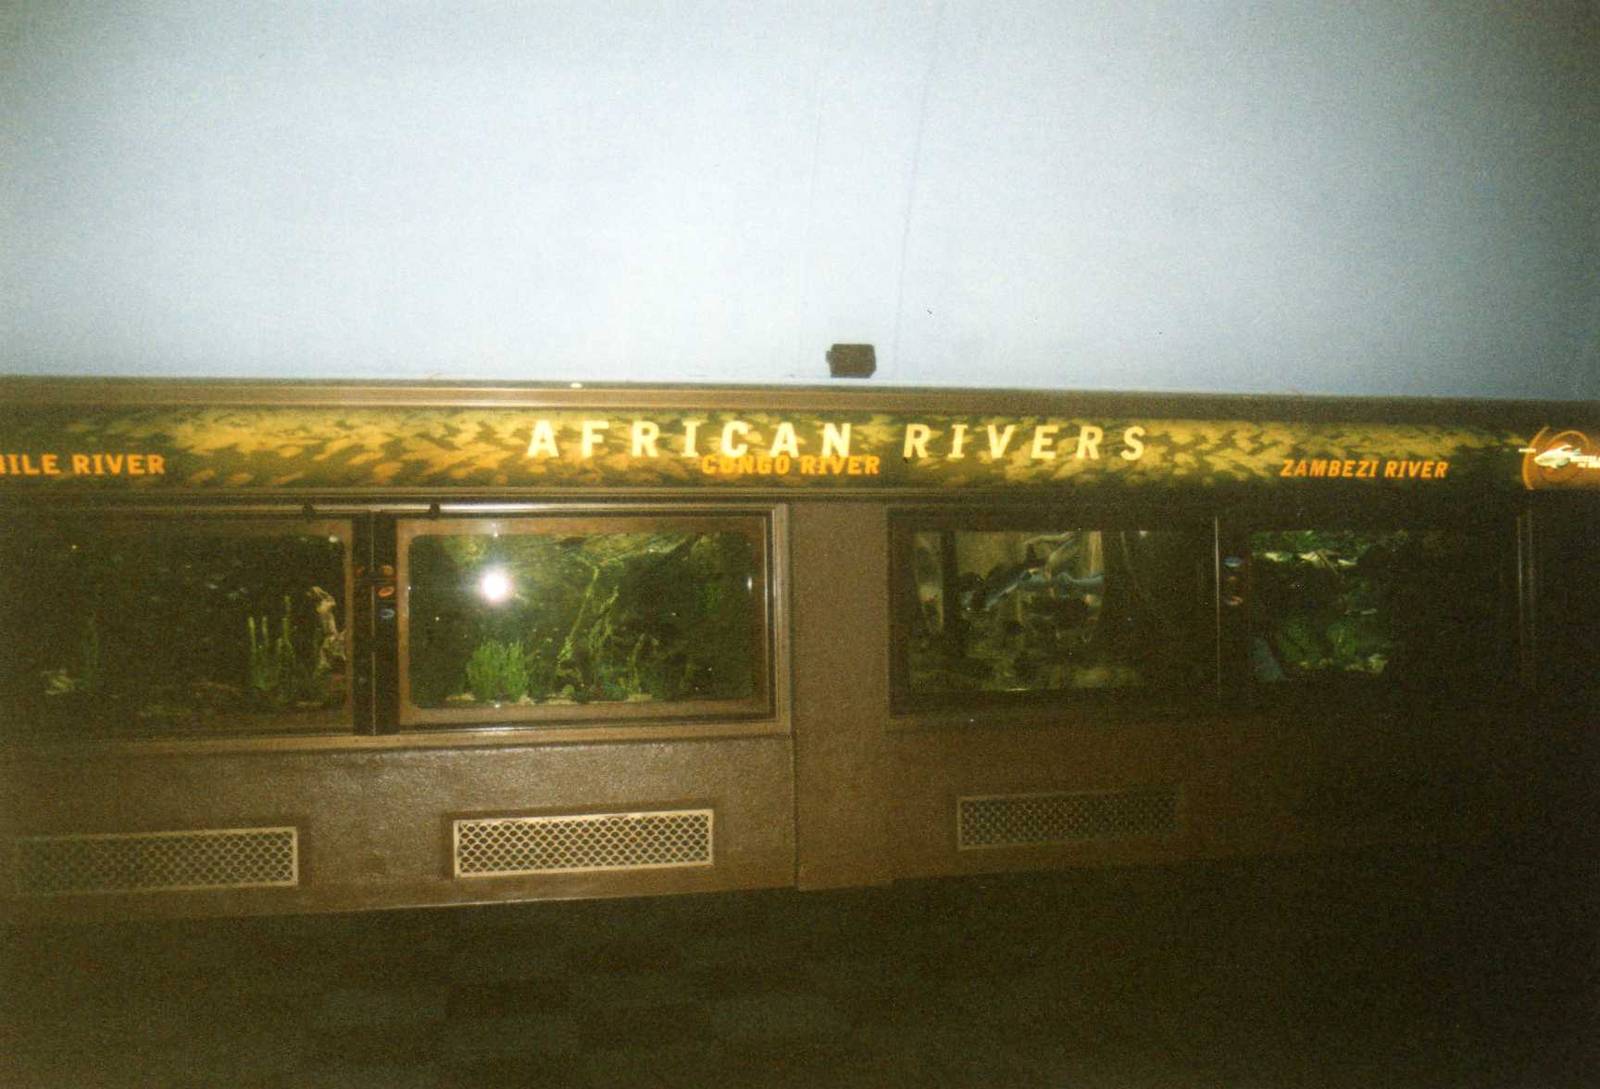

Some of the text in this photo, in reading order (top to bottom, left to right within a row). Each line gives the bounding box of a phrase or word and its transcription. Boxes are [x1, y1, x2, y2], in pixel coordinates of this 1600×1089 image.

[527, 420, 1146, 460] AFRICAN RIVERS
[72, 453, 165, 475] RIVER
[702, 454, 880, 475] CONGO RIVER
[1279, 459, 1449, 479] ZAMBEZI RIVER
